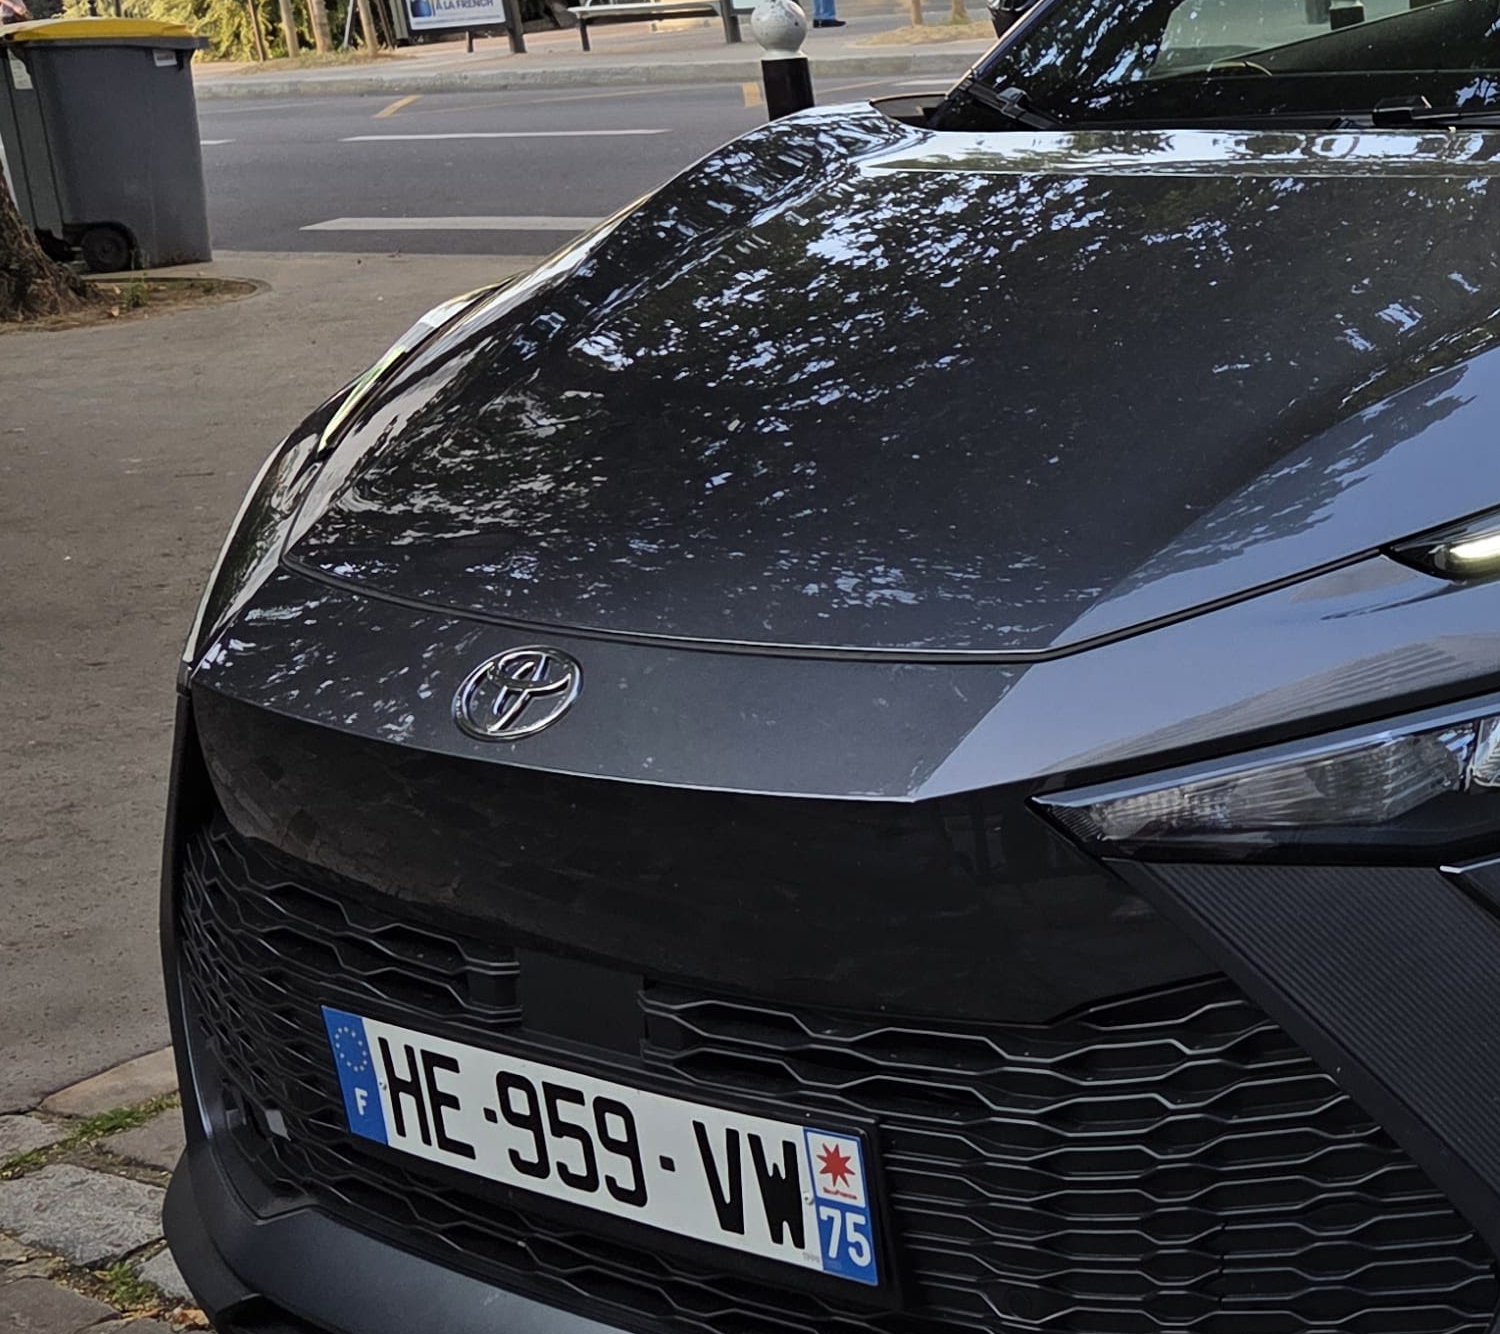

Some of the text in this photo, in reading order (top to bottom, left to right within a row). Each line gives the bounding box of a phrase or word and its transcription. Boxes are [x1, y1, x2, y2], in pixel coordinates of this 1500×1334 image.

[353, 1036, 805, 1250] F HE-959-VW
[819, 1205, 871, 1267] 75
